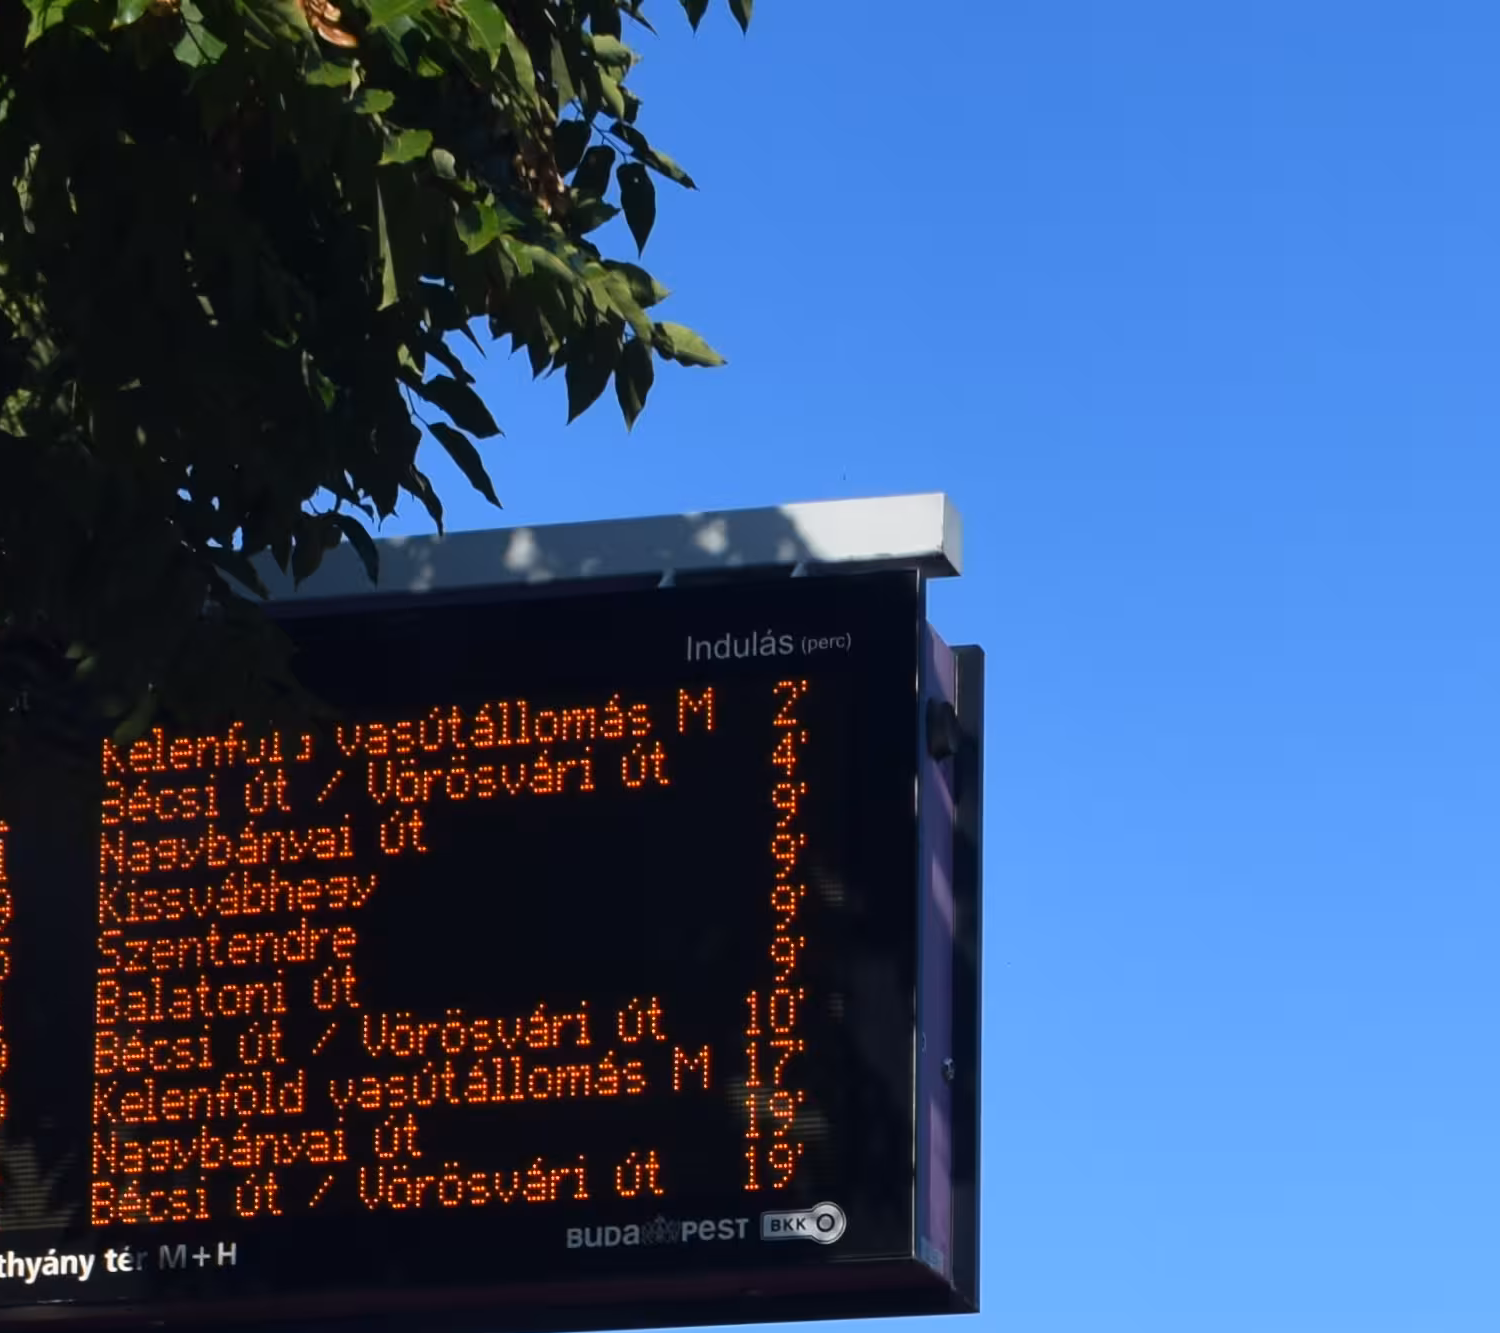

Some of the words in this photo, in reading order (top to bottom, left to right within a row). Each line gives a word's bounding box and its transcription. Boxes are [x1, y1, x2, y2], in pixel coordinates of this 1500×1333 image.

[687, 630, 794, 660] Indulás
[802, 633, 852, 655] (perc)
[336, 693, 651, 756] vasútállomás
[678, 686, 712, 733] M
[245, 768, 291, 814] út
[368, 746, 595, 804] Vörösvári
[622, 741, 669, 785] út
[100, 813, 353, 874] Nagybányai
[381, 809, 427, 855] út
[99, 868, 376, 923] Kissvábhegy
[98, 916, 357, 973] Szentendre
[96, 969, 286, 1023] Balatoni
[313, 964, 359, 1010] út
[95, 1024, 212, 1074] Bécsi
[240, 1019, 285, 1065] út
[362, 1000, 591, 1057] Vörösvári
[618, 996, 667, 1042] út
[93, 1068, 304, 1124] Kelenföld
[329, 1050, 647, 1109] vasútállomás
[675, 1045, 709, 1091] M
[93, 1117, 348, 1175] Nagybányai
[375, 1113, 422, 1158] út
[91, 1174, 210, 1225] Bécsi
[237, 1170, 284, 1217] út
[360, 1155, 588, 1209] Vörösvári
[616, 1150, 665, 1196] út
[771, 1216, 807, 1233] BKK
[104, 1245, 149, 1272] tér
